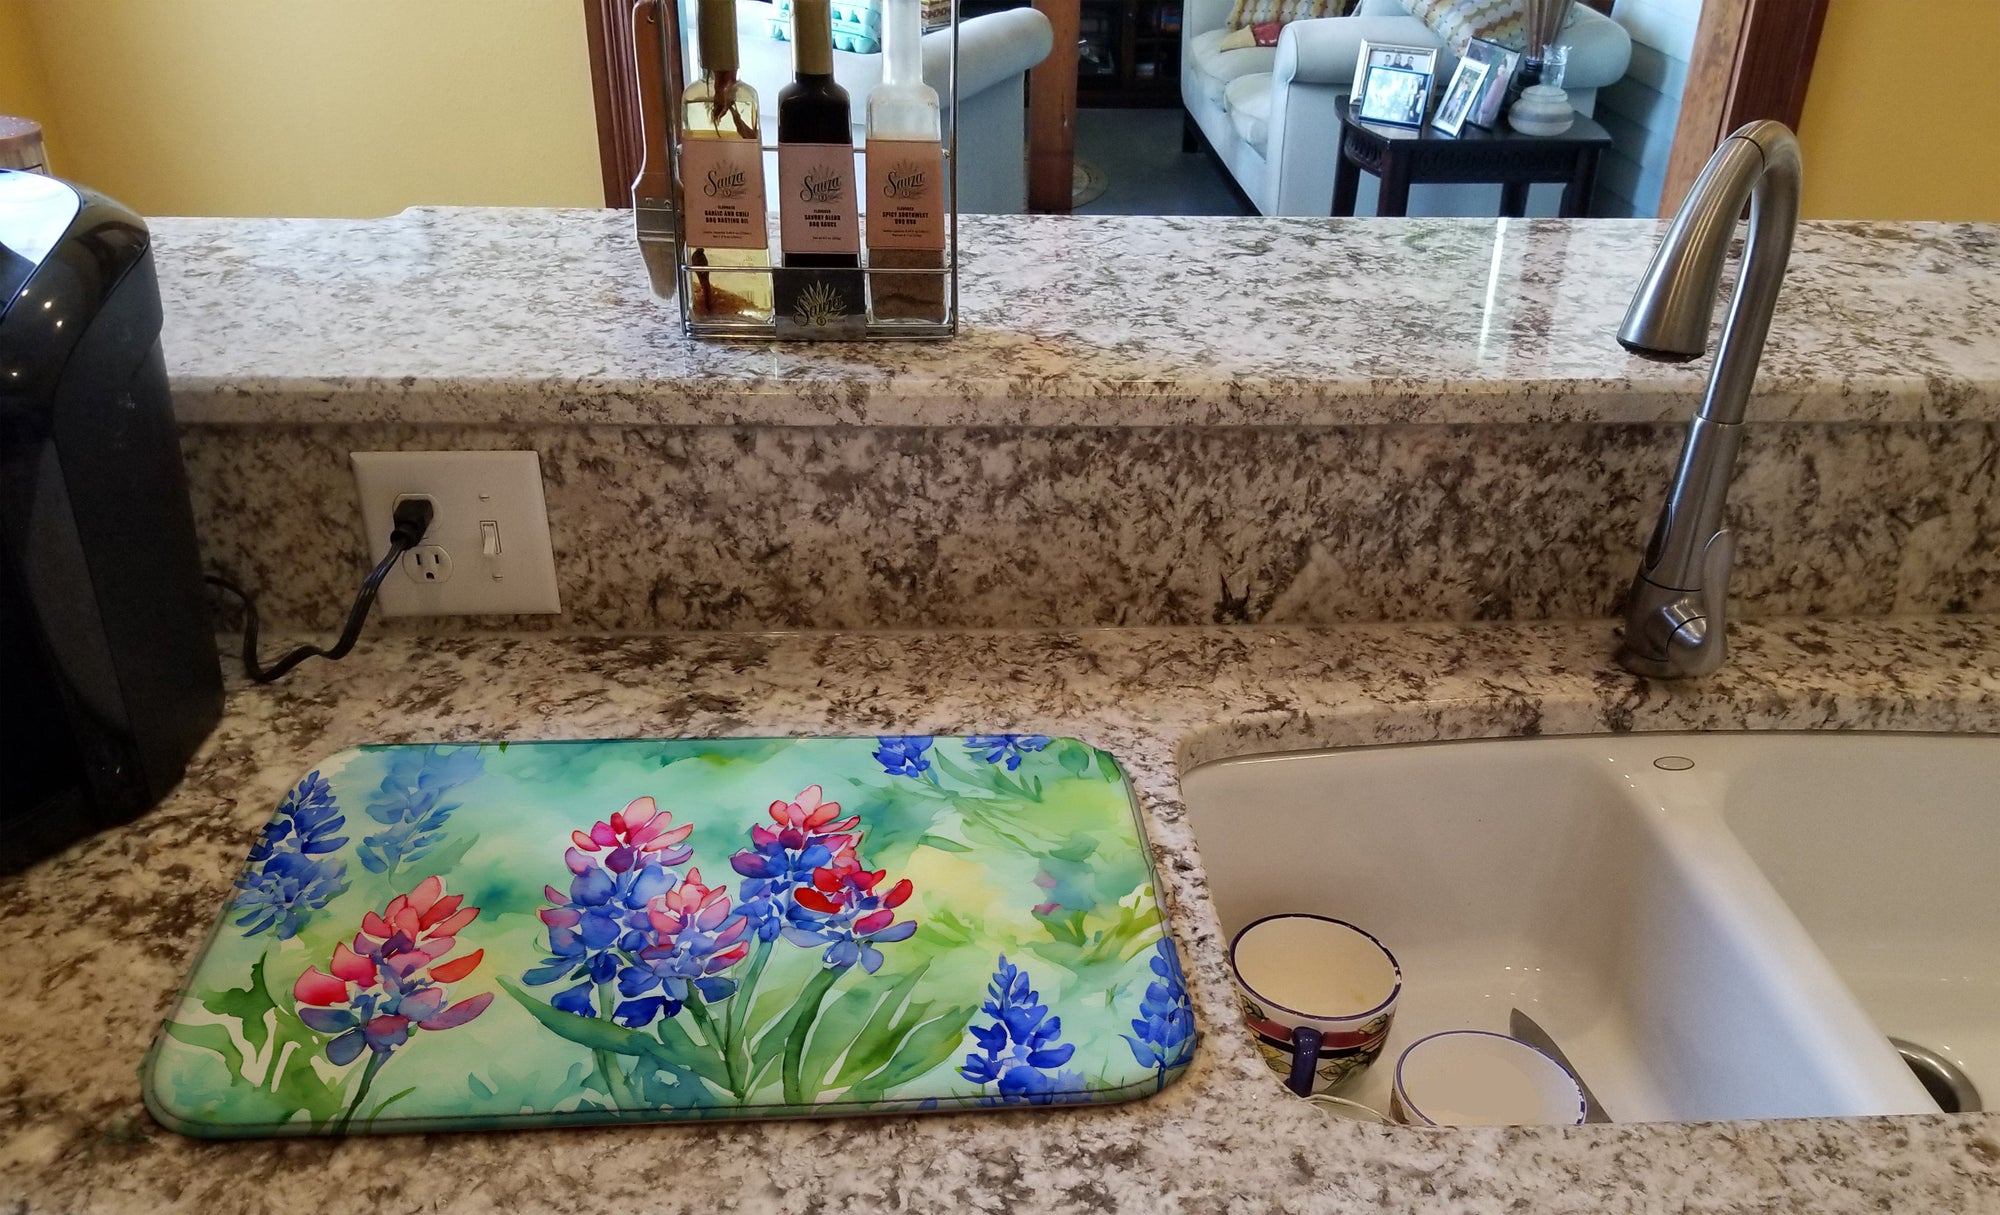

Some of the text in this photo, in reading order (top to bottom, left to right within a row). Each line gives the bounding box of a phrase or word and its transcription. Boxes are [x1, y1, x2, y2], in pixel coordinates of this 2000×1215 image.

[704, 170, 745, 197] Sauza
[800, 175, 842, 202] Sauza
[884, 171, 926, 198] Sauza
